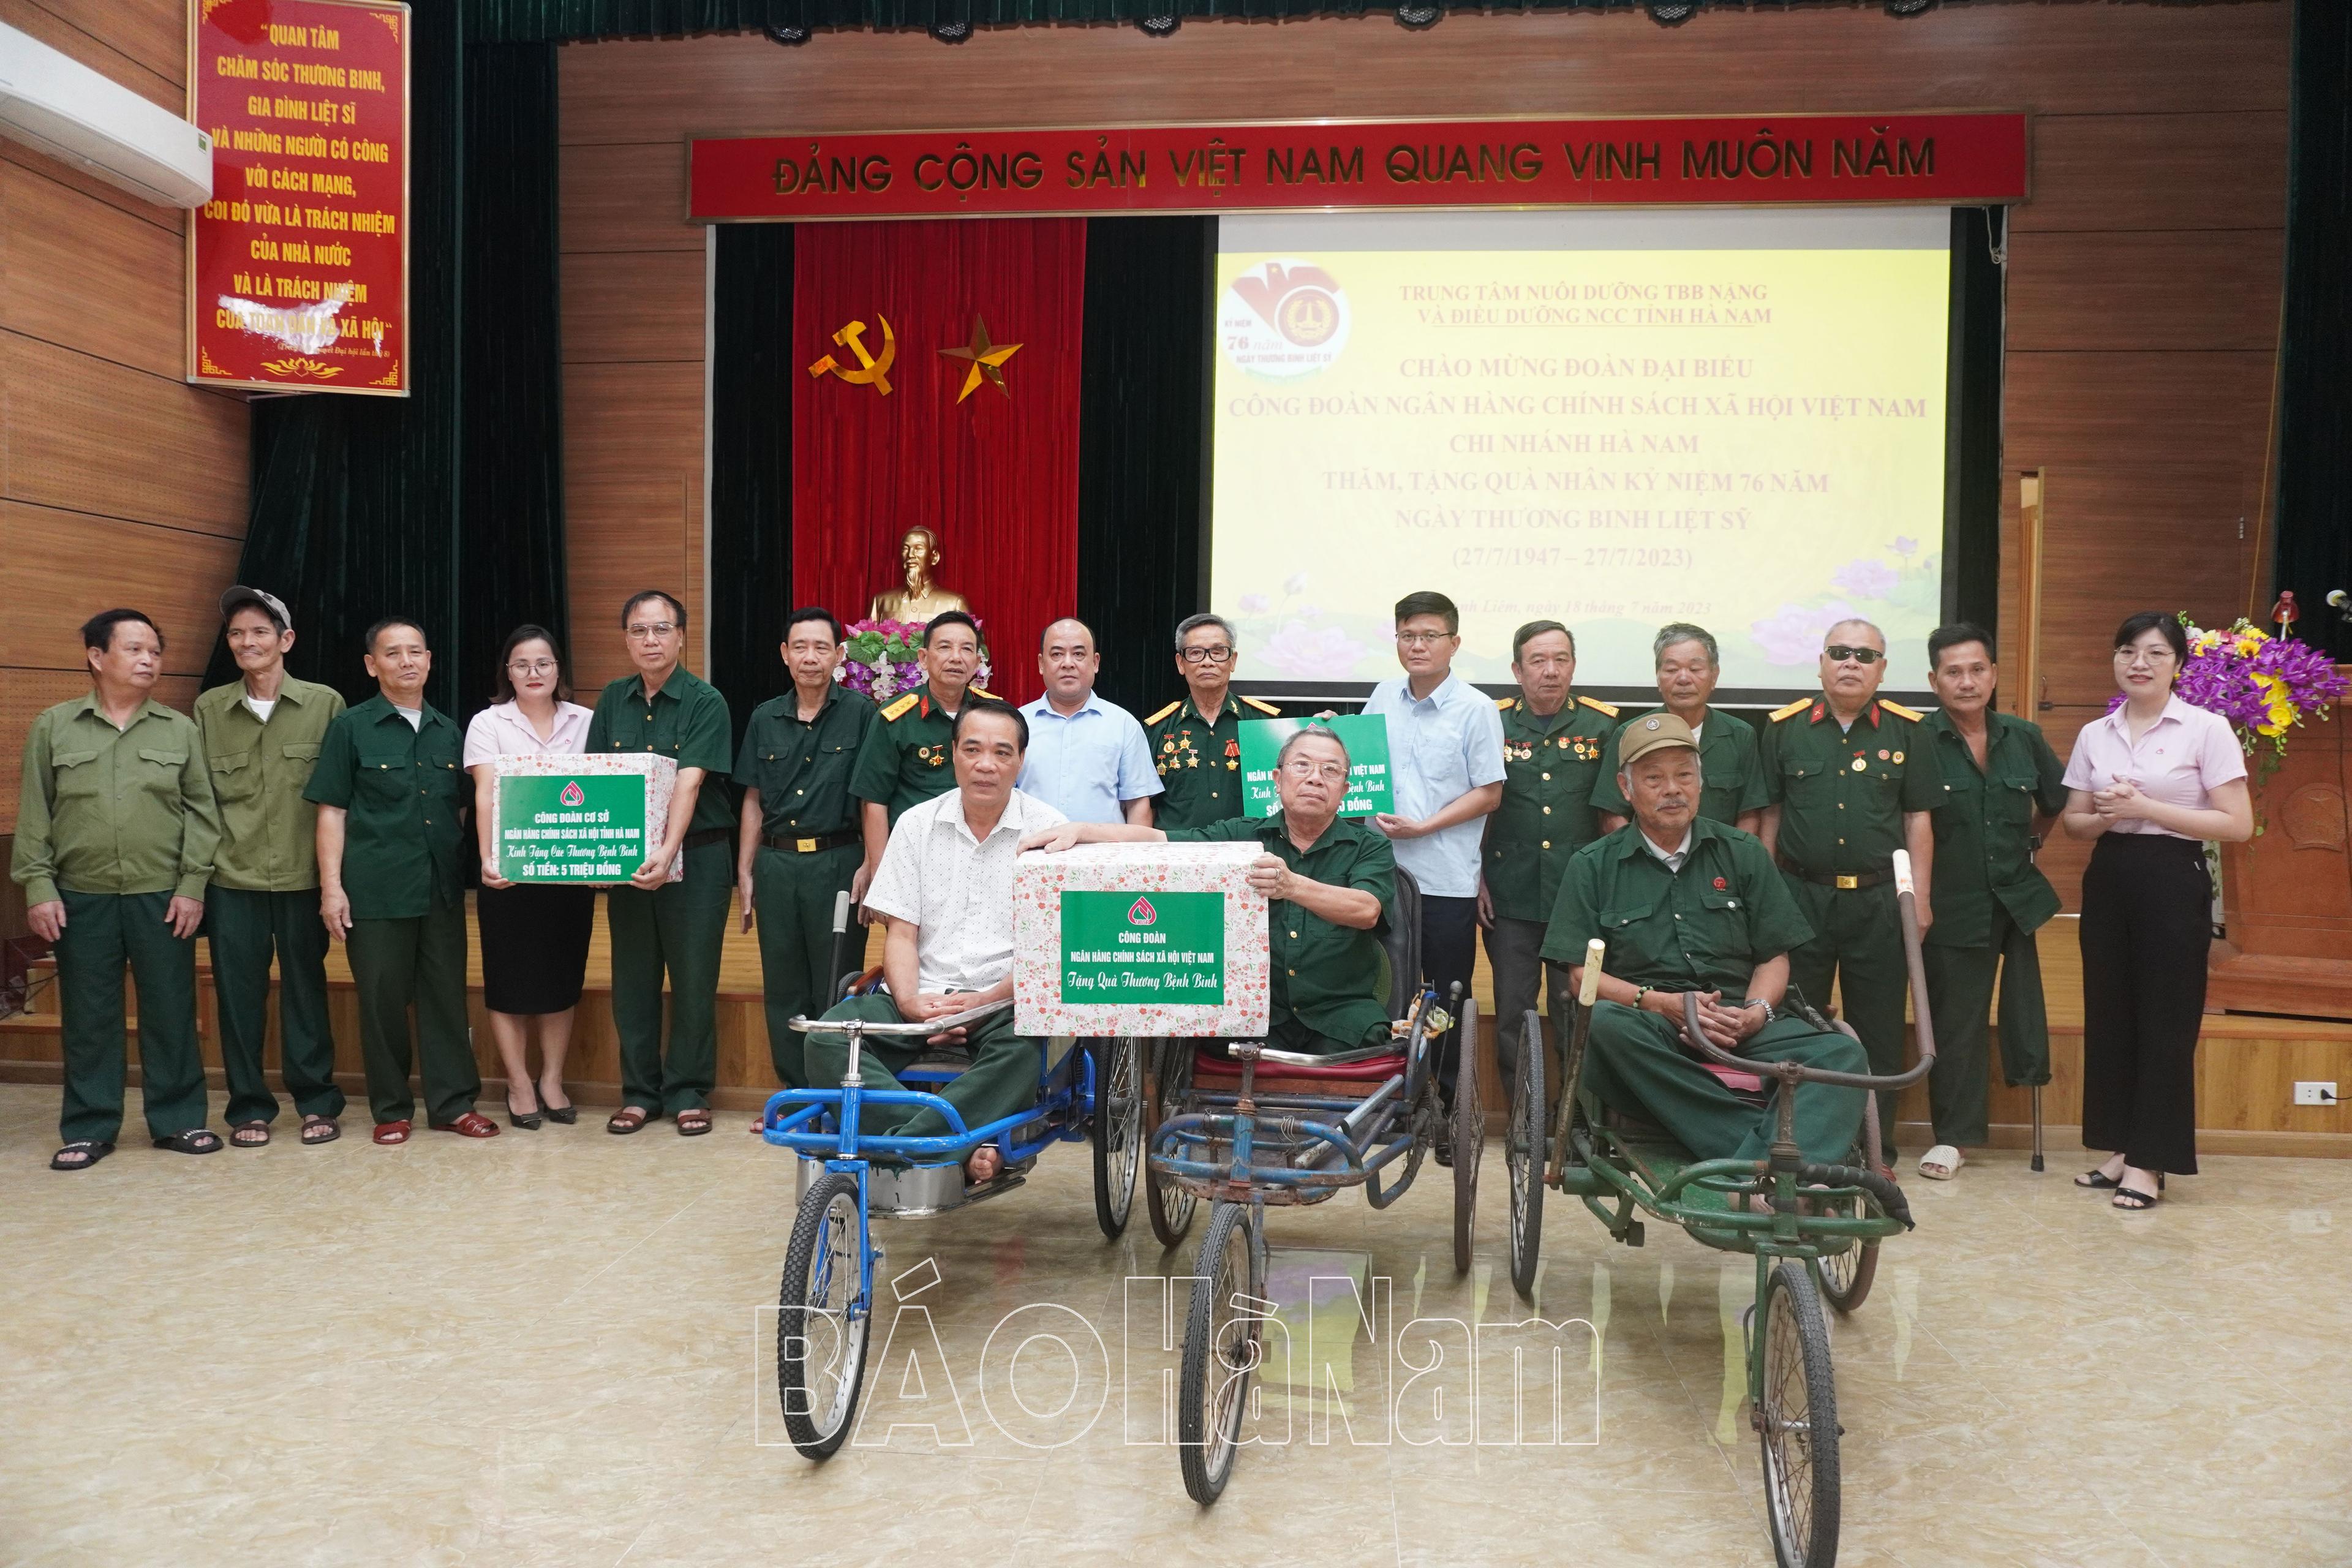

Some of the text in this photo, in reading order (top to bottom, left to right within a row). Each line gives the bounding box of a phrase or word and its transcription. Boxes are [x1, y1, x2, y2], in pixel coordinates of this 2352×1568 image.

[311, 24, 339, 50] TÂM
[217, 54, 385, 93] CHĂM SÓC THƯƠNG BINH,
[248, 96, 356, 126] GIA ĐÌNH LIỆT SĨ
[211, 125, 230, 148] VÀ
[234, 127, 282, 154] NHỮNG
[285, 133, 327, 157] NGƯỜI
[331, 137, 349, 160] CÓ
[352, 138, 389, 163] CÔNG
[772, 125, 1935, 202] ĐẢNG CỘNG SẢN VIỆT NAM QUANG VINH MUÔN NĂM
[245, 163, 356, 198] VỚI CÁCH MẠNG,
[203, 199, 395, 238] COI ĐÓ VỪA LÀ TRÁCH NHIỆM
[251, 233, 352, 267] CỦA NHÀ NƯỚC
[233, 271, 368, 307] VÀ LÀ TRÁCH NHIỆM
[1399, 281, 1768, 304] TRUNG TÂM NUÔI DƯỠNG TBB NẶNG
[1417, 304, 1772, 324] VÀ ĐIỀU DƯỠNG NCC TỈNH HÀ NAM
[341, 316, 359, 339] XÃ
[1227, 336, 1250, 350] 76
[1400, 353, 1755, 383] CHÀO MỪNG ĐOÀN ĐẠI BIỂU
[1229, 390, 1927, 421] CÔNG ĐOÀN NGÂN HÀNG CHÍNH SÁCH XÃ HỘI VIỆT NAM
[1449, 428, 1699, 453] CHI NHÁNH HÀ NAM
[1322, 465, 1403, 494] THĂM,
[1408, 469, 1479, 496] TẶNG
[1484, 467, 1538, 495] QUÀ
[1545, 467, 1616, 491] NHÂN
[1665, 469, 1733, 497] NIỆM
[1740, 473, 1764, 492] 76
[1770, 469, 1829, 492] NĂM
[1395, 503, 1753, 534] NGÀY THƯƠNG BINH LIỆT SỸ
[1452, 546, 1693, 570] (27/7/1947 27/7/2023)
[1564, 600, 1582, 613] 18
[1631, 601, 1640, 613] 7
[1642, 601, 1673, 613] năm
[1676, 601, 1712, 614] 2023
[1246, 769, 1266, 782] NGÂN
[1353, 763, 1368, 777] VIỆT
[1369, 764, 1385, 775] NAM
[1365, 780, 1385, 793] Binh
[1347, 796, 1372, 812] ĐỒNG
[535, 809, 609, 823] CÔNG ĐOÀN CƠ SỞ
[505, 826, 639, 841] NGÂN HÀNG CHÍNH SÁCH XÃ HỘI TỈNH HÀ NAM
[551, 845, 564, 858] Các
[567, 844, 596, 859] Thương
[597, 844, 617, 859] Bệnh
[619, 844, 638, 856] Binh
[522, 860, 621, 878] SỐ TIỀN: 5 TRIỆU ĐỒNG
[1118, 930, 1166, 943] CÔNG ĐOÀN
[1071, 949, 1214, 965] NGÂN HÀNG CHÍNH SÁCH XÃ HỘI VIỆT NAM
[1067, 971, 1218, 990] Tặng Quà Thương Bệnh Binh
